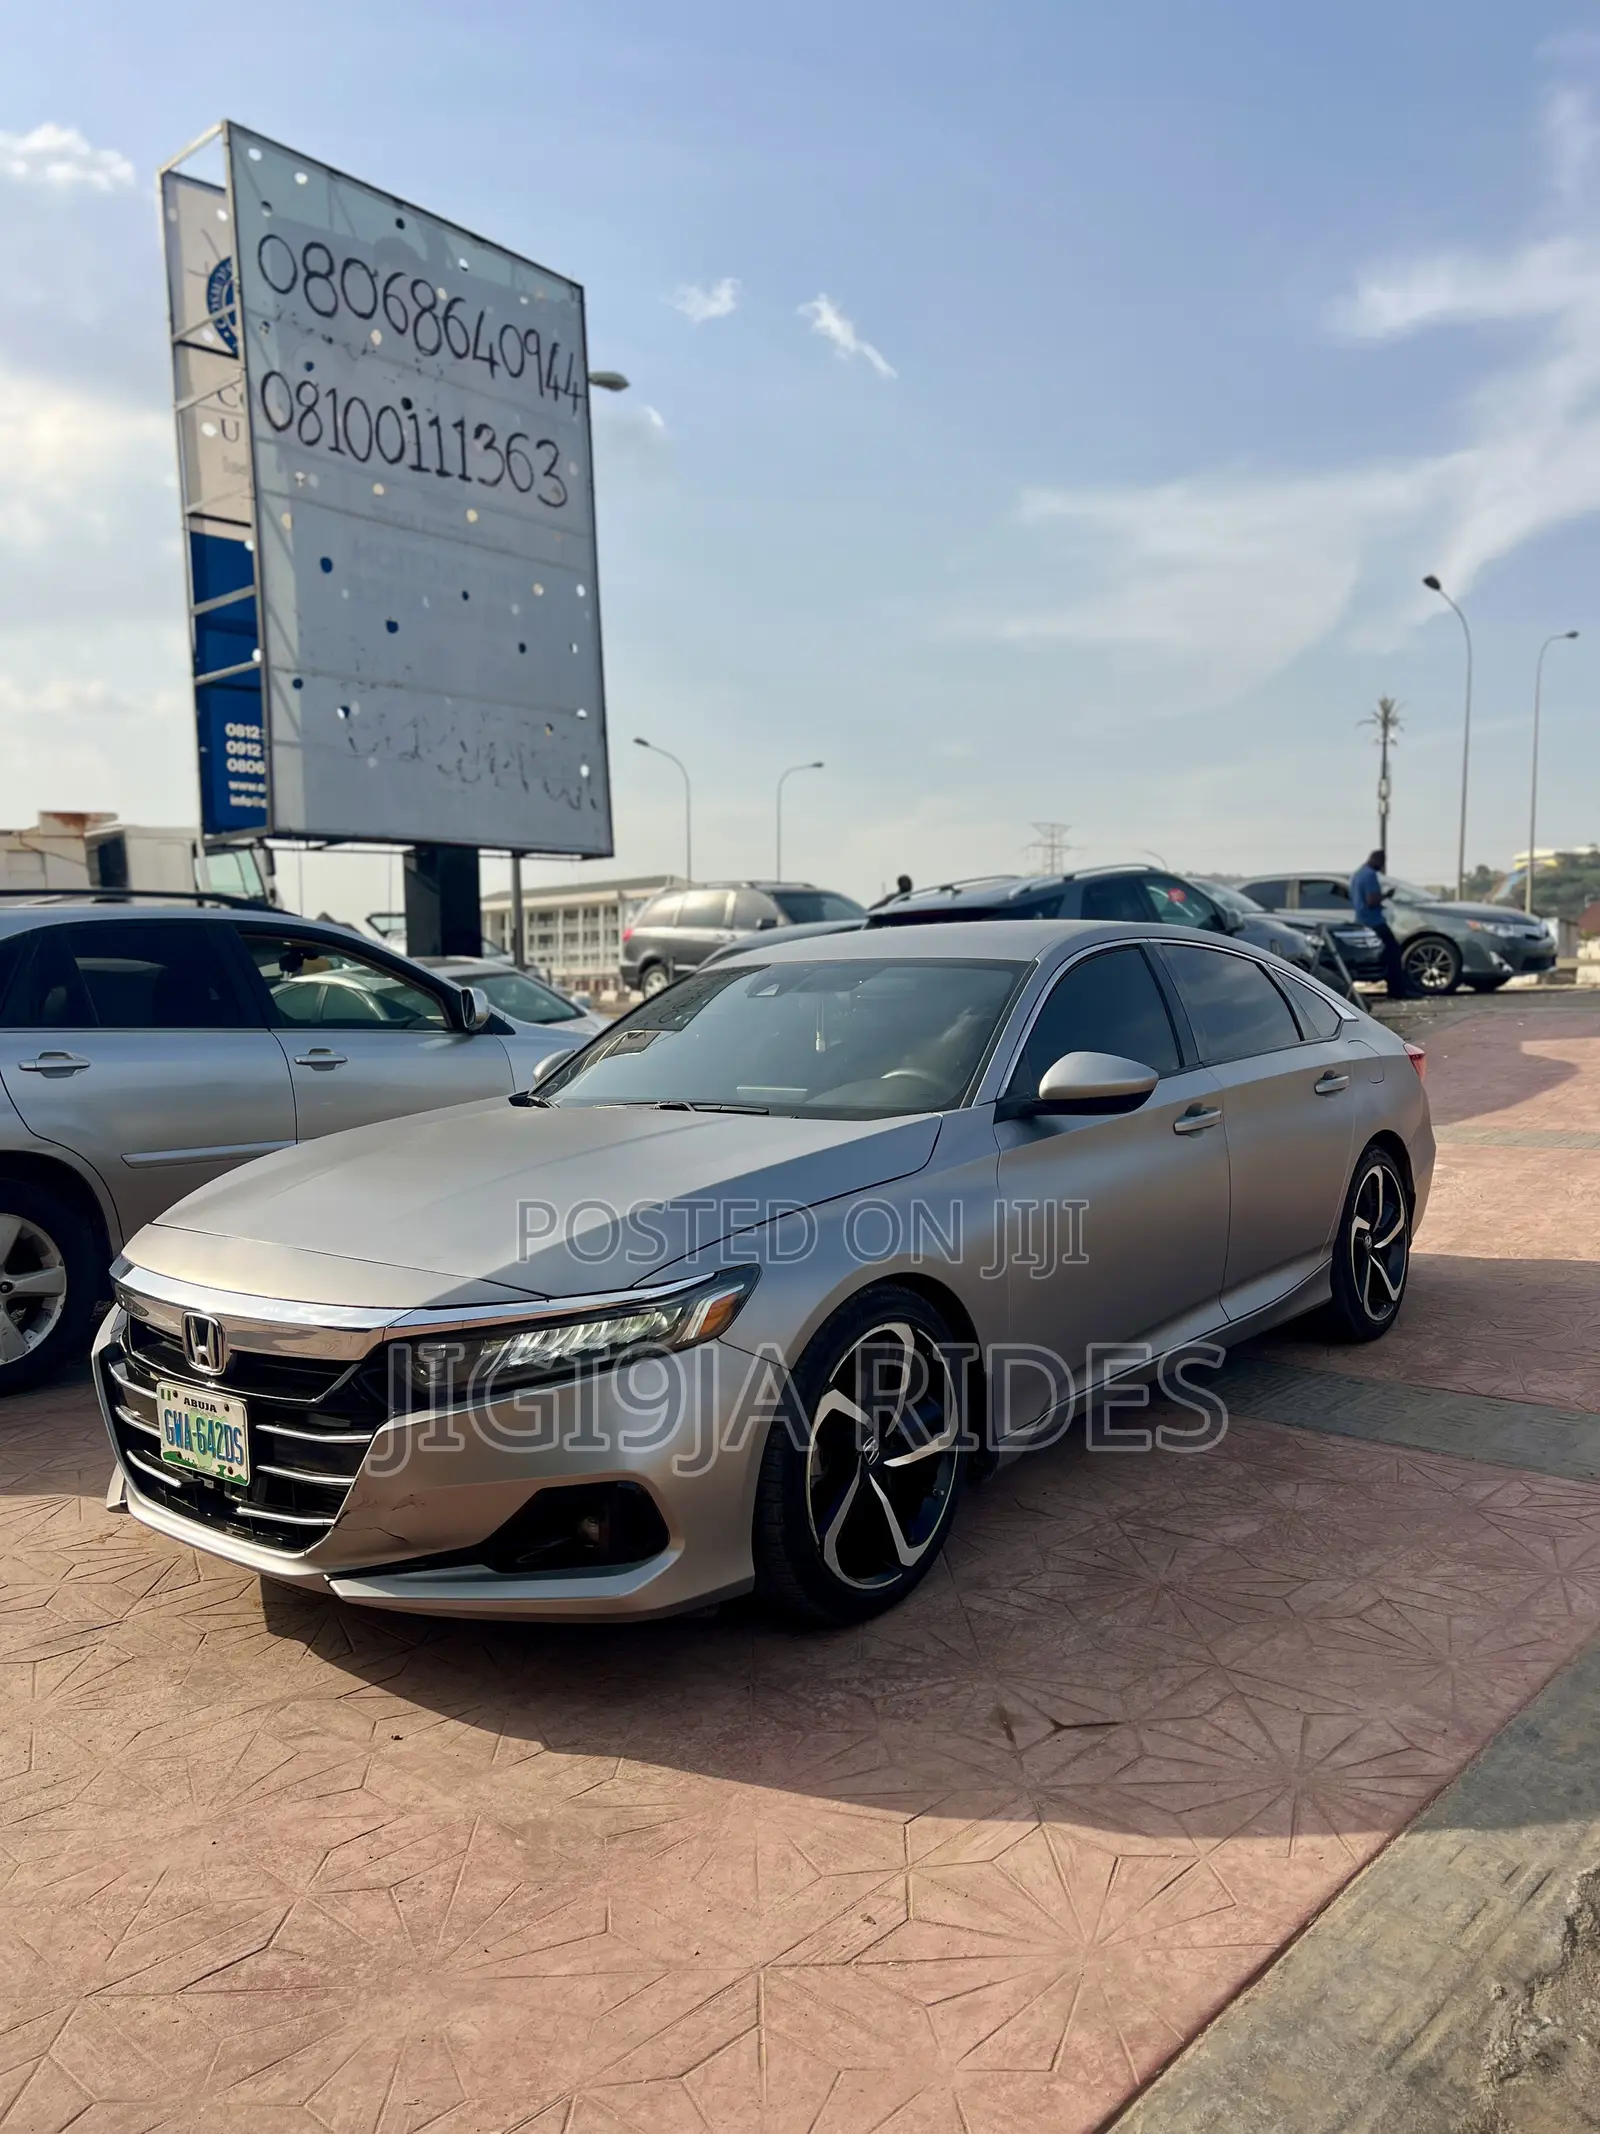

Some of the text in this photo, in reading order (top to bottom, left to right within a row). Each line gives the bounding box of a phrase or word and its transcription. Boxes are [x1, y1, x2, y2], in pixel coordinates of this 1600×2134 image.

[258, 234, 584, 415] 08068640944
[260, 371, 568, 508] 08100111363
[164, 1408, 244, 1466] GWA-642DS
[183, 1397, 218, 1413] ABUJA
